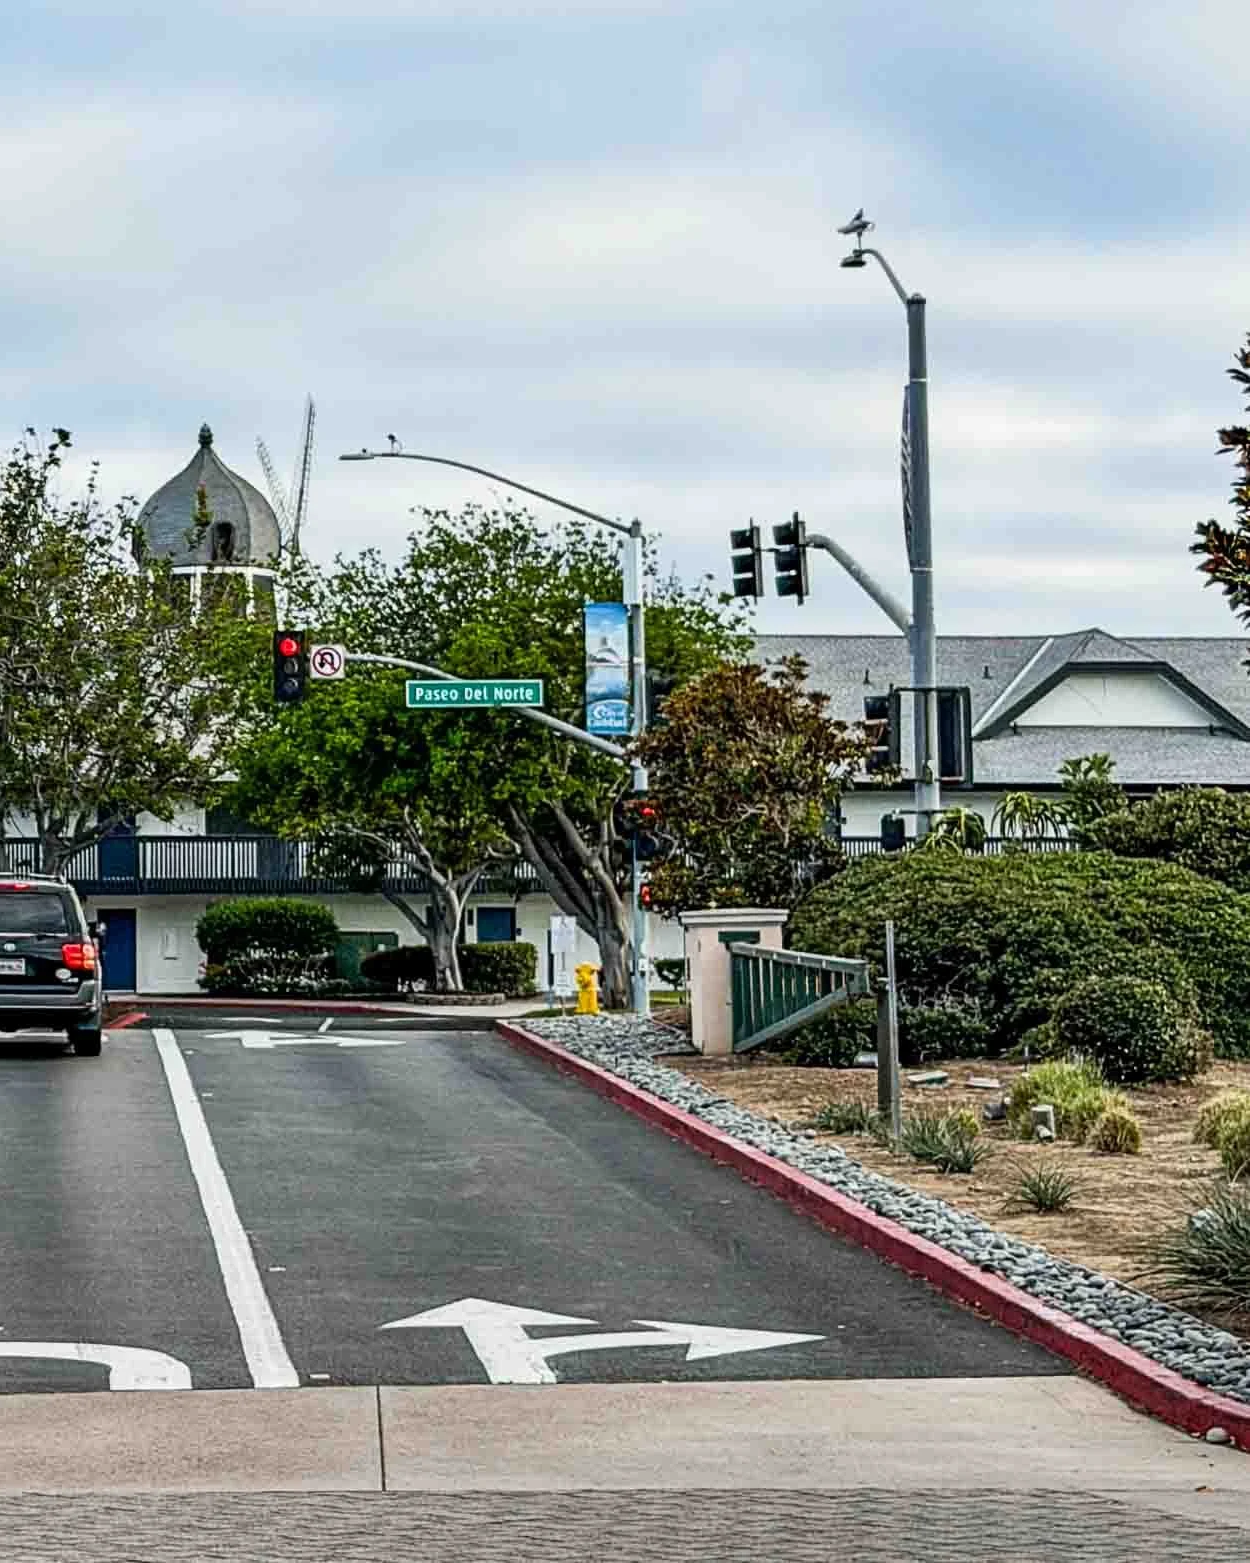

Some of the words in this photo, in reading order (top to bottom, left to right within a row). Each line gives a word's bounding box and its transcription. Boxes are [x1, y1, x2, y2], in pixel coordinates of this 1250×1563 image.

[415, 687, 459, 701] Paseo
[464, 686, 488, 701] Del
[493, 687, 534, 701] Norte
